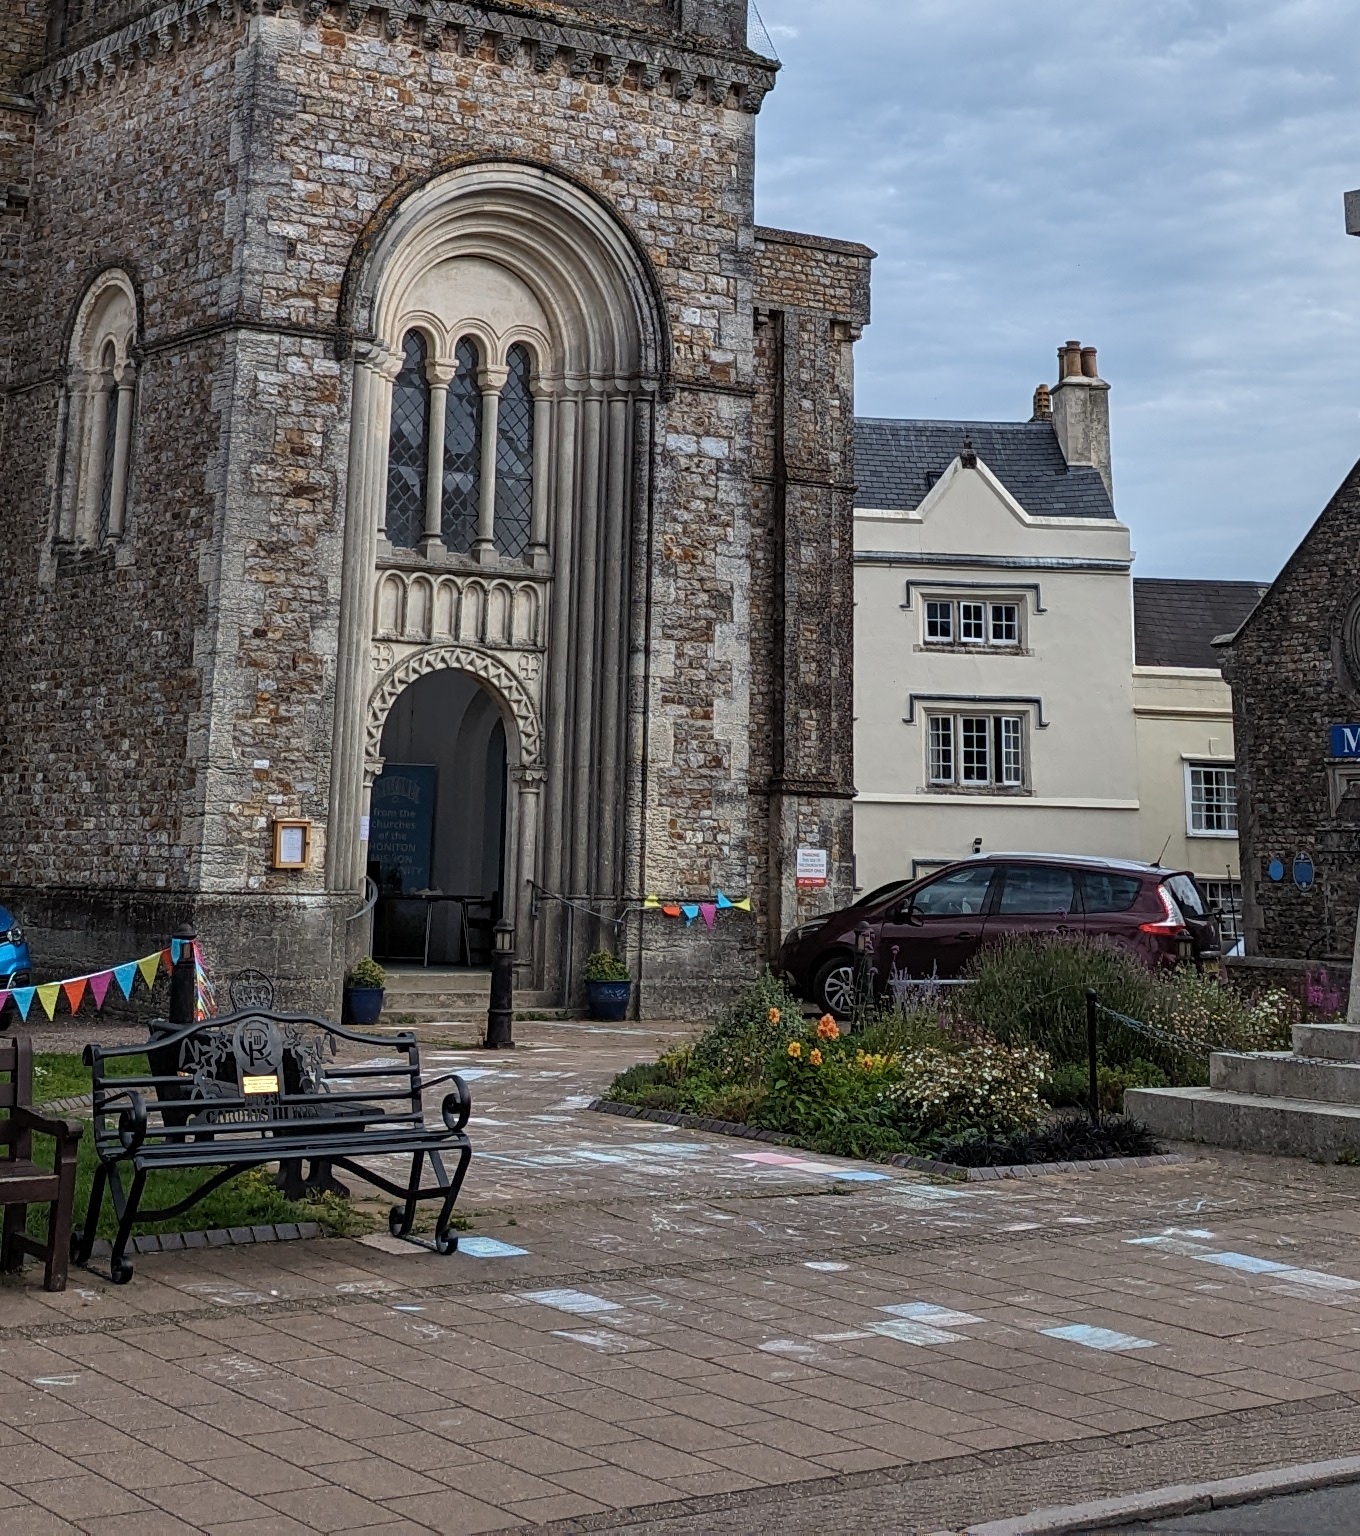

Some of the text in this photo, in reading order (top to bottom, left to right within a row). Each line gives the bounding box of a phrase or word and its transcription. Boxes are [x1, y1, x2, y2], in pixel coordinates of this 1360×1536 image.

[374, 808, 416, 818] from the
[372, 820, 416, 829] churches
[369, 843, 416, 852] HONITON
[206, 1108, 269, 1124] CAROLUS
[272, 1106, 289, 1120] III
